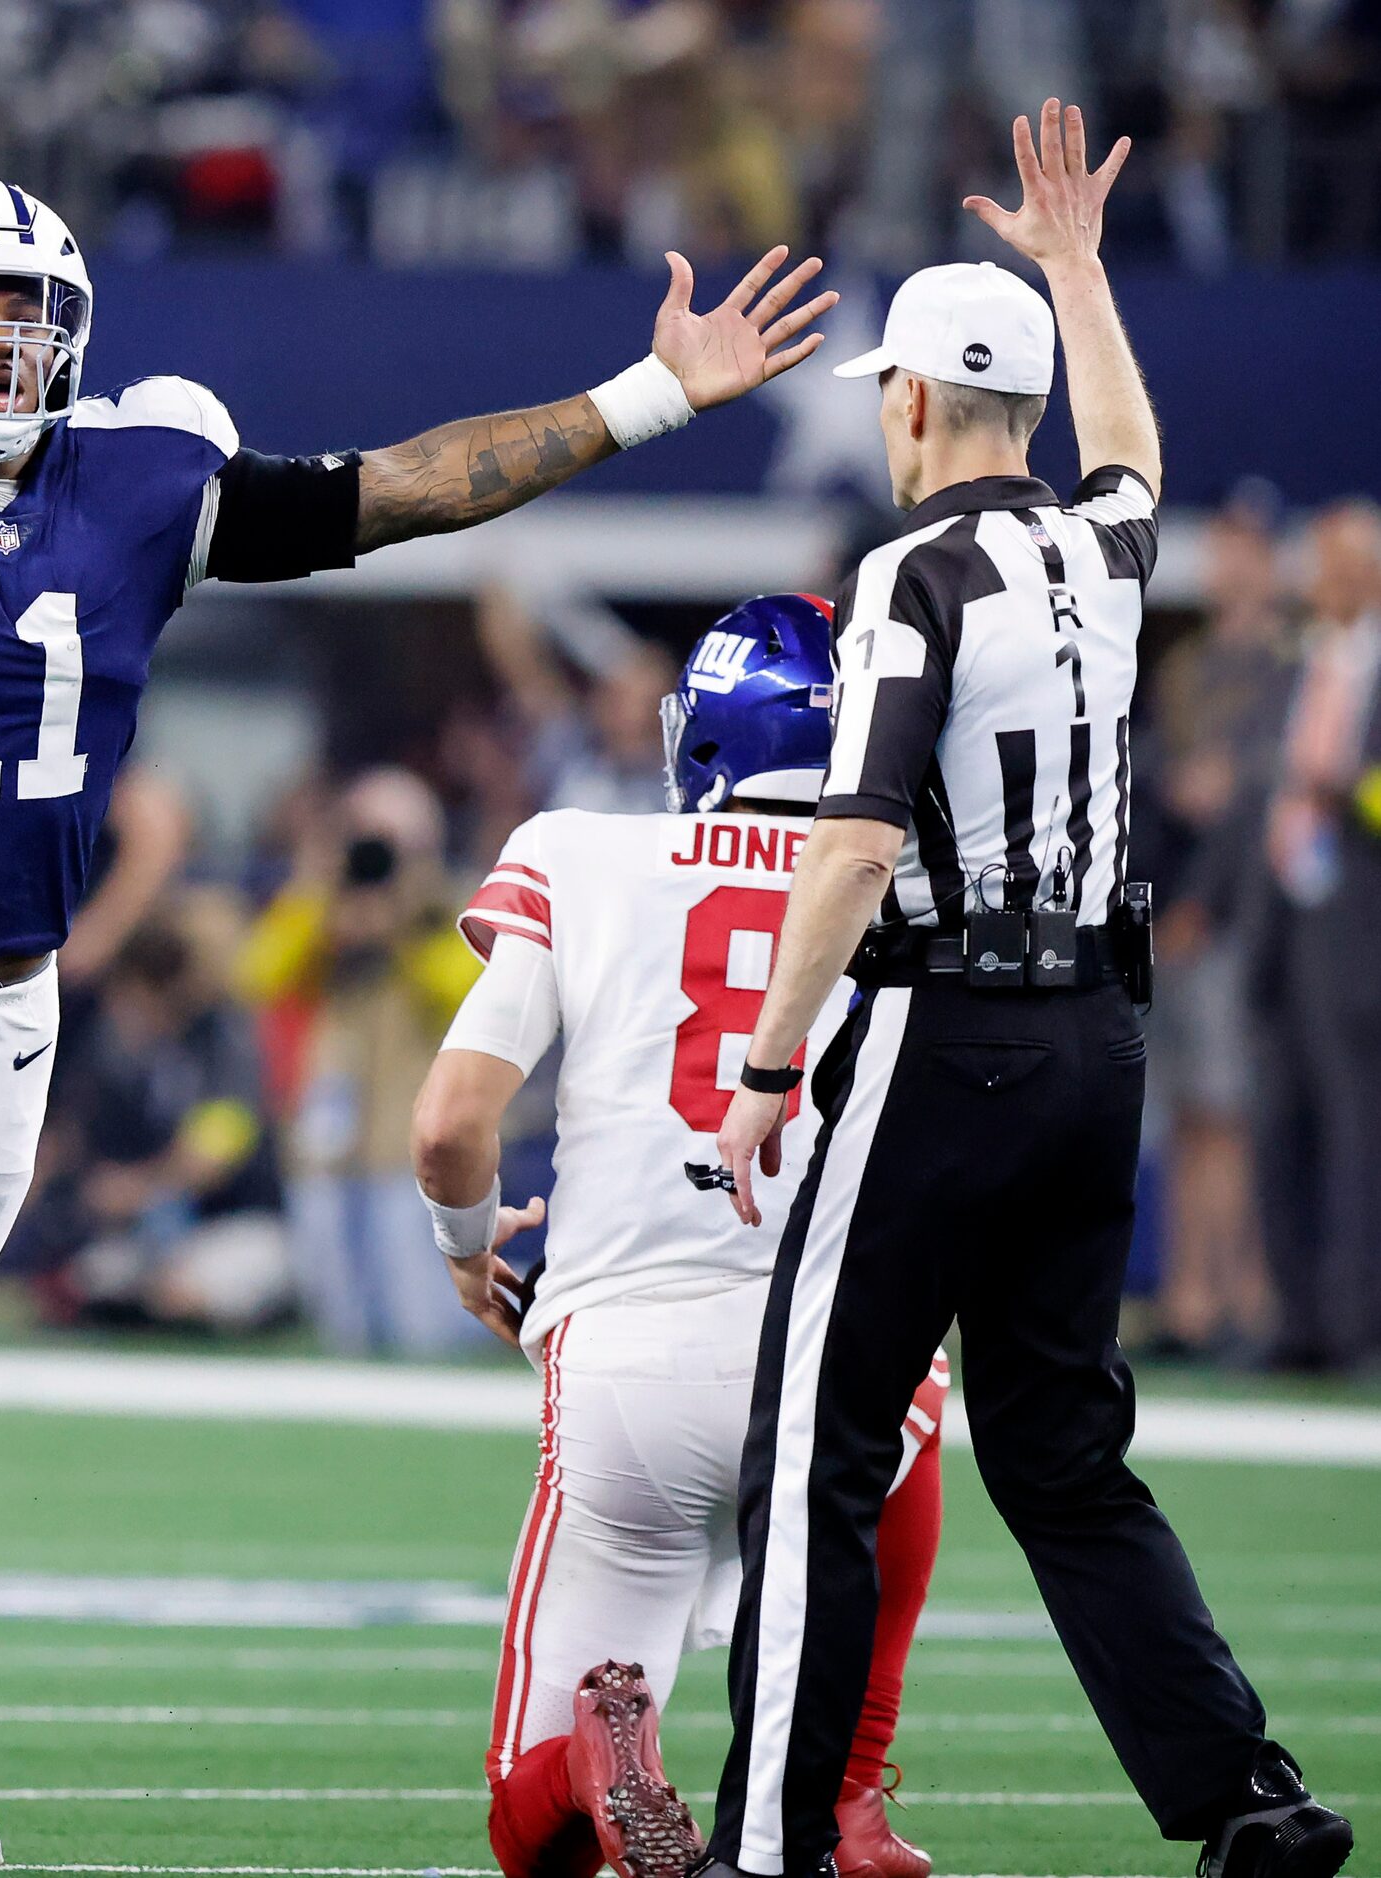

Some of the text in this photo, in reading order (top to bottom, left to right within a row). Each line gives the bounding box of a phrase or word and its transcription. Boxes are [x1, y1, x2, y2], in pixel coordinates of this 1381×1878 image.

[964, 350, 990, 365] WM
[1048, 588, 1083, 632] R
[856, 629, 875, 670] 1
[1056, 641, 1086, 718] 1
[669, 885, 808, 1133] 8
